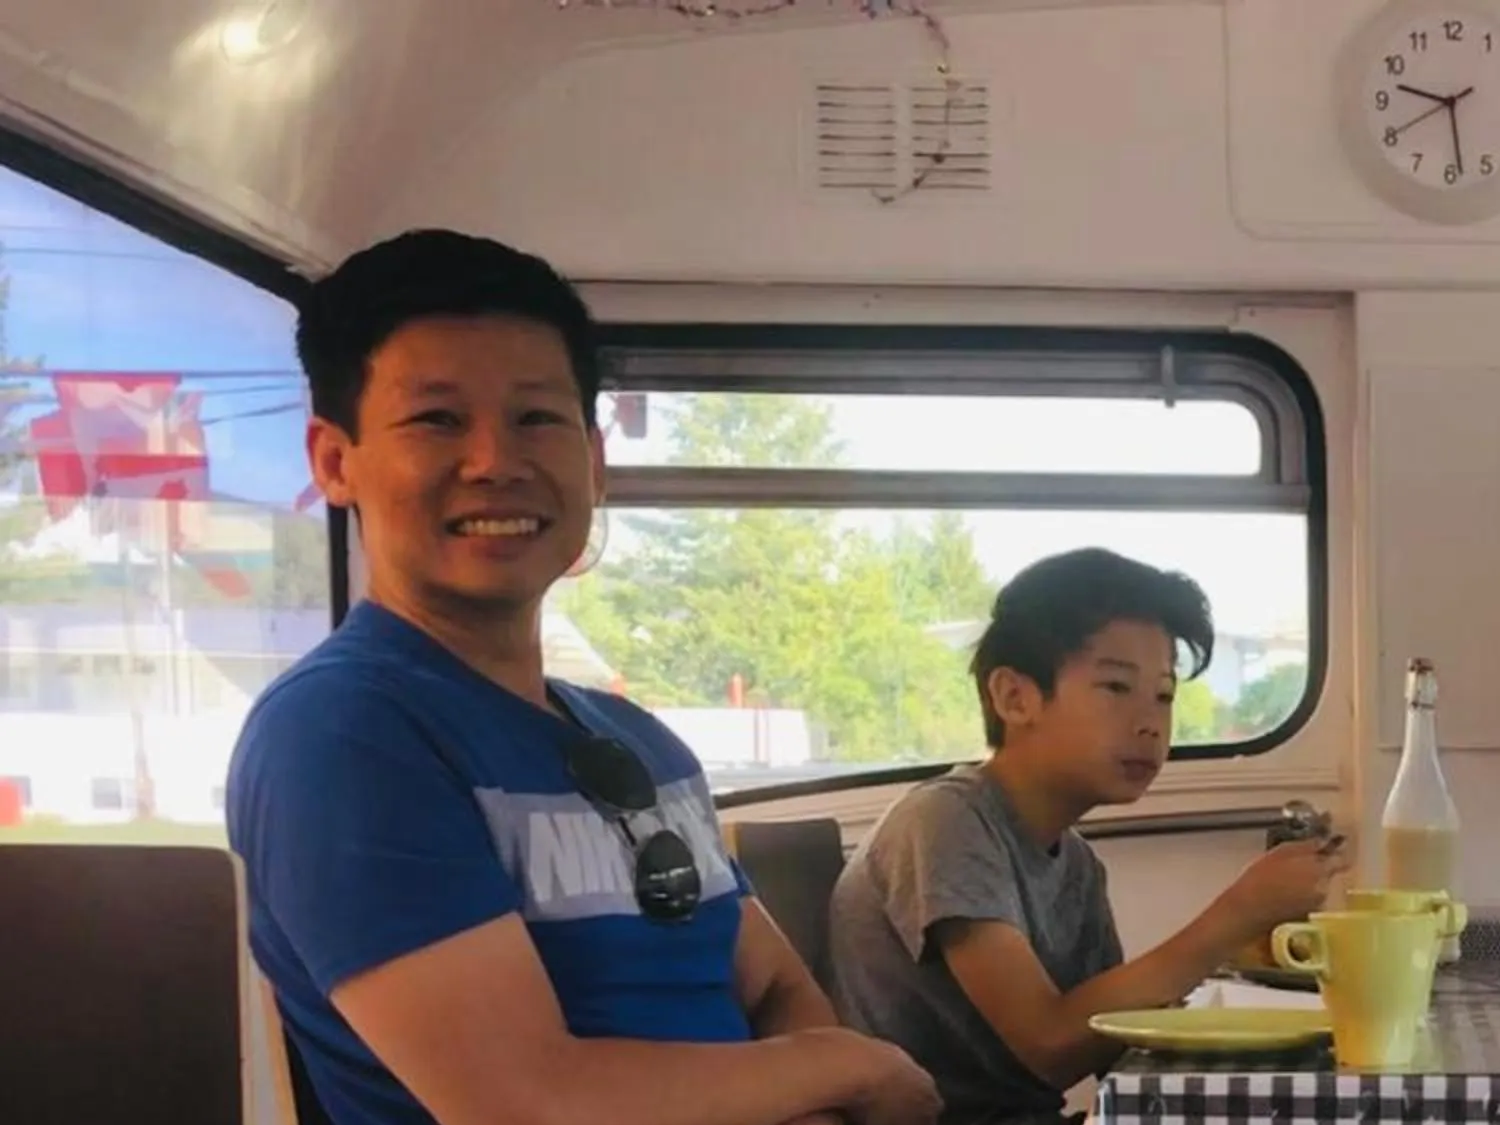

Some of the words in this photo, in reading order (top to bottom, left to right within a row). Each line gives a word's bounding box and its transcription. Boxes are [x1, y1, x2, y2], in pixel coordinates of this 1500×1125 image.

[1409, 32, 1427, 50] 11
[1443, 20, 1463, 41] 12
[1484, 33, 1492, 51] 1
[1384, 54, 1405, 75] 10
[1375, 90, 1389, 111] 9
[1383, 126, 1398, 147] 8
[1411, 153, 1424, 172] 7
[1480, 154, 1493, 175] 5
[1444, 164, 1457, 185] 6
